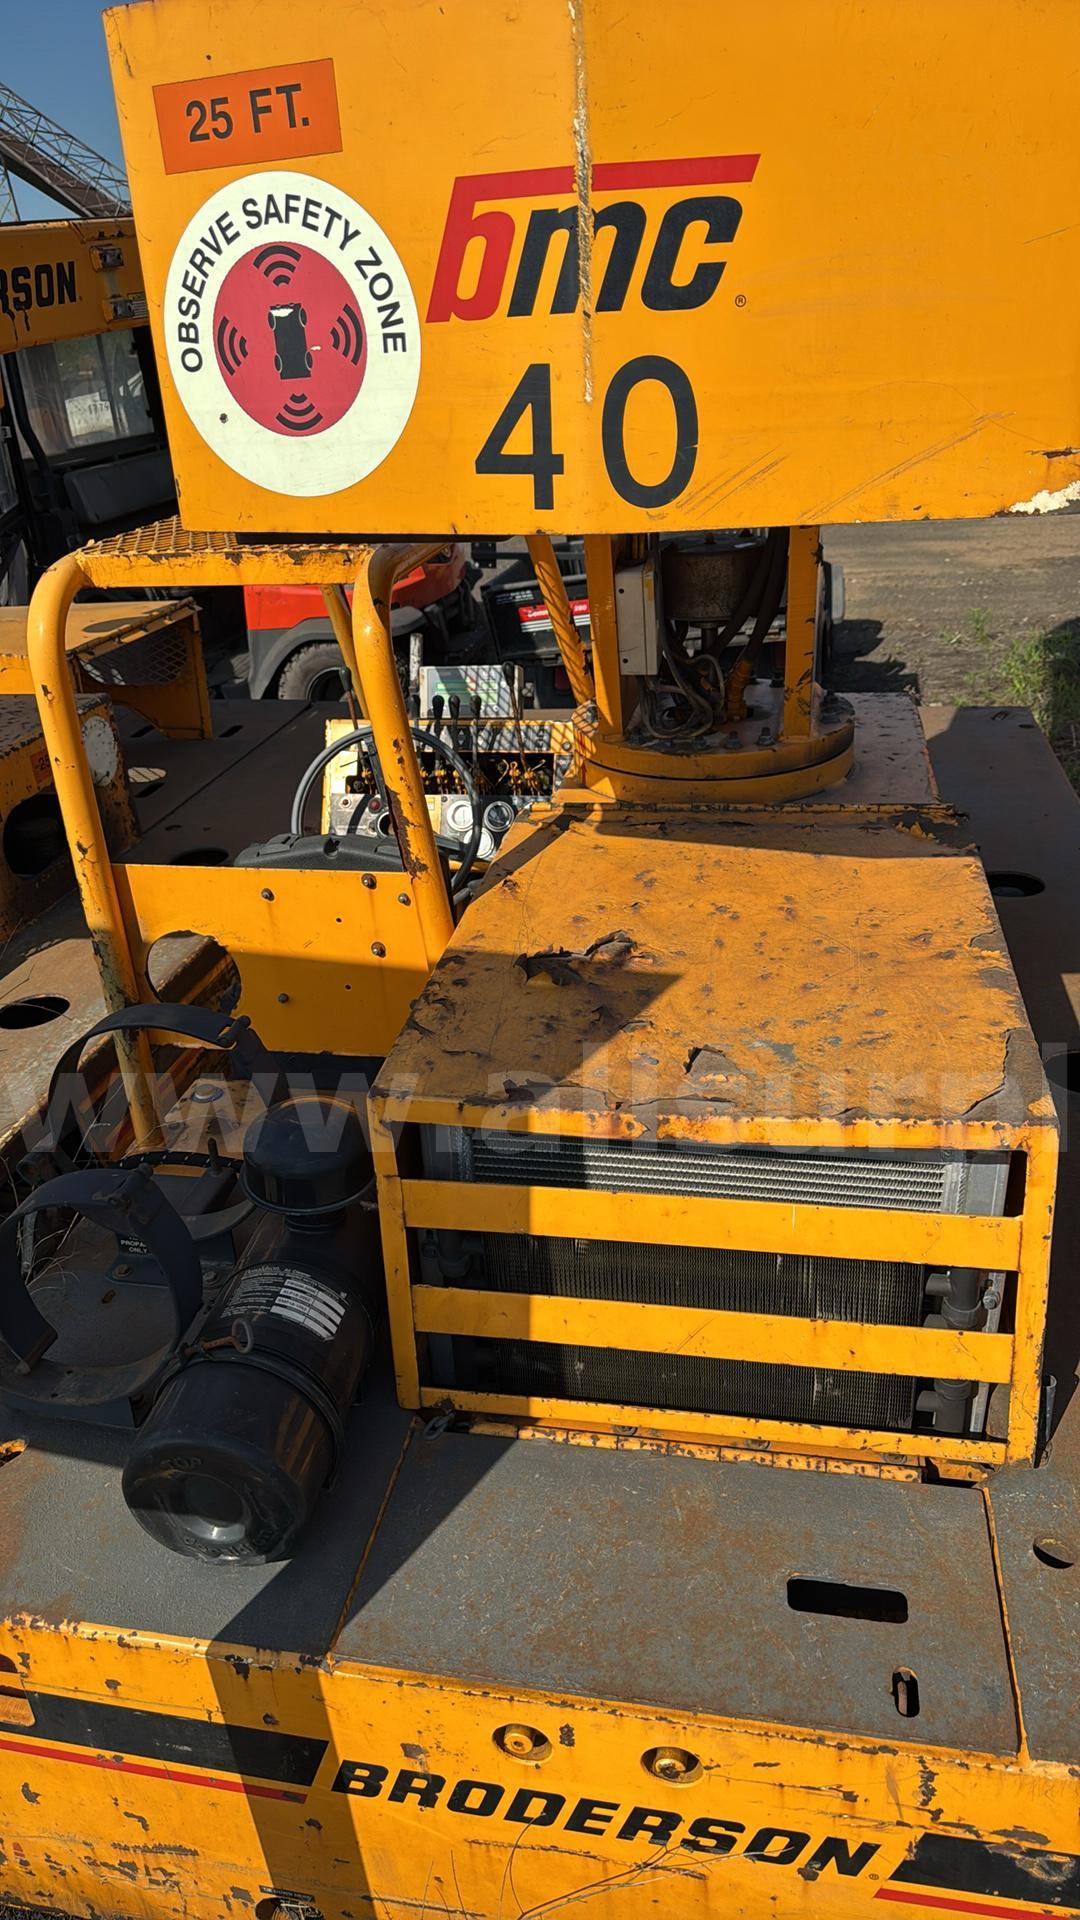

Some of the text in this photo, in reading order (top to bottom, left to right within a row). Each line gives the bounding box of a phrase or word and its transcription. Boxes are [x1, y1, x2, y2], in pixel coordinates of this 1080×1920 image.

[185, 82, 311, 143] 25 FT.
[177, 193, 408, 374] OBSERVE SAFETY ZONE
[426, 153, 761, 323] bmc
[475, 354, 699, 511] 40
[120, 1239, 147, 1247] PROPA
[330, 1759, 882, 1878] BRODERSON
